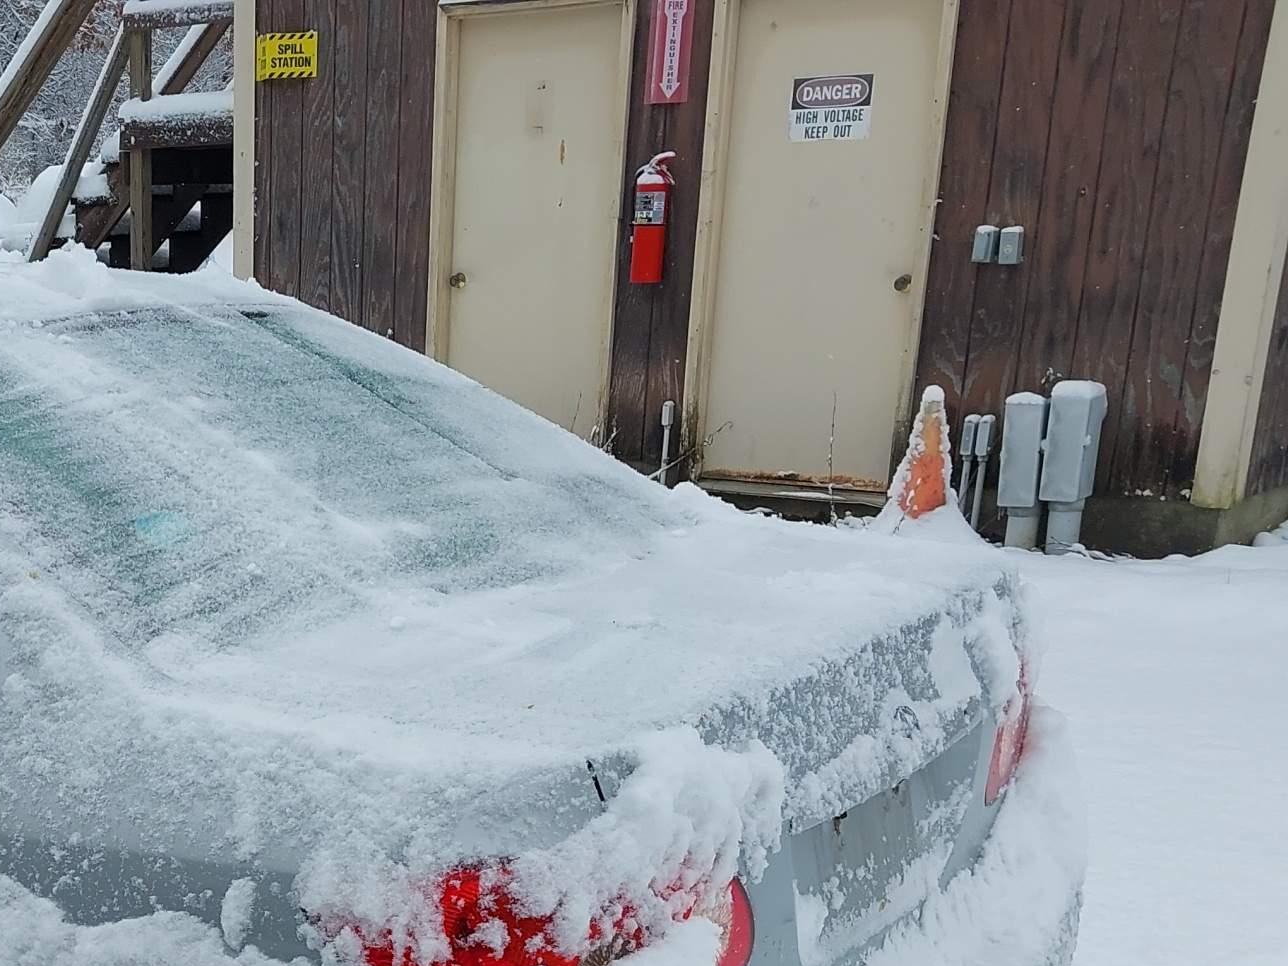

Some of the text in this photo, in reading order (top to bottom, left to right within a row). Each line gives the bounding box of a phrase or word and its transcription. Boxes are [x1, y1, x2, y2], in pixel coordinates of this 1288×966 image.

[668, 1, 684, 9] FIRE
[278, 43, 305, 55] SPILL
[665, 12, 678, 90] EXTINGUISHER
[270, 56, 312, 69] STATION
[802, 83, 862, 102] DANGER
[795, 108, 865, 125] HIGH VOLTAGE
[804, 124, 853, 139] KEEP OUT
